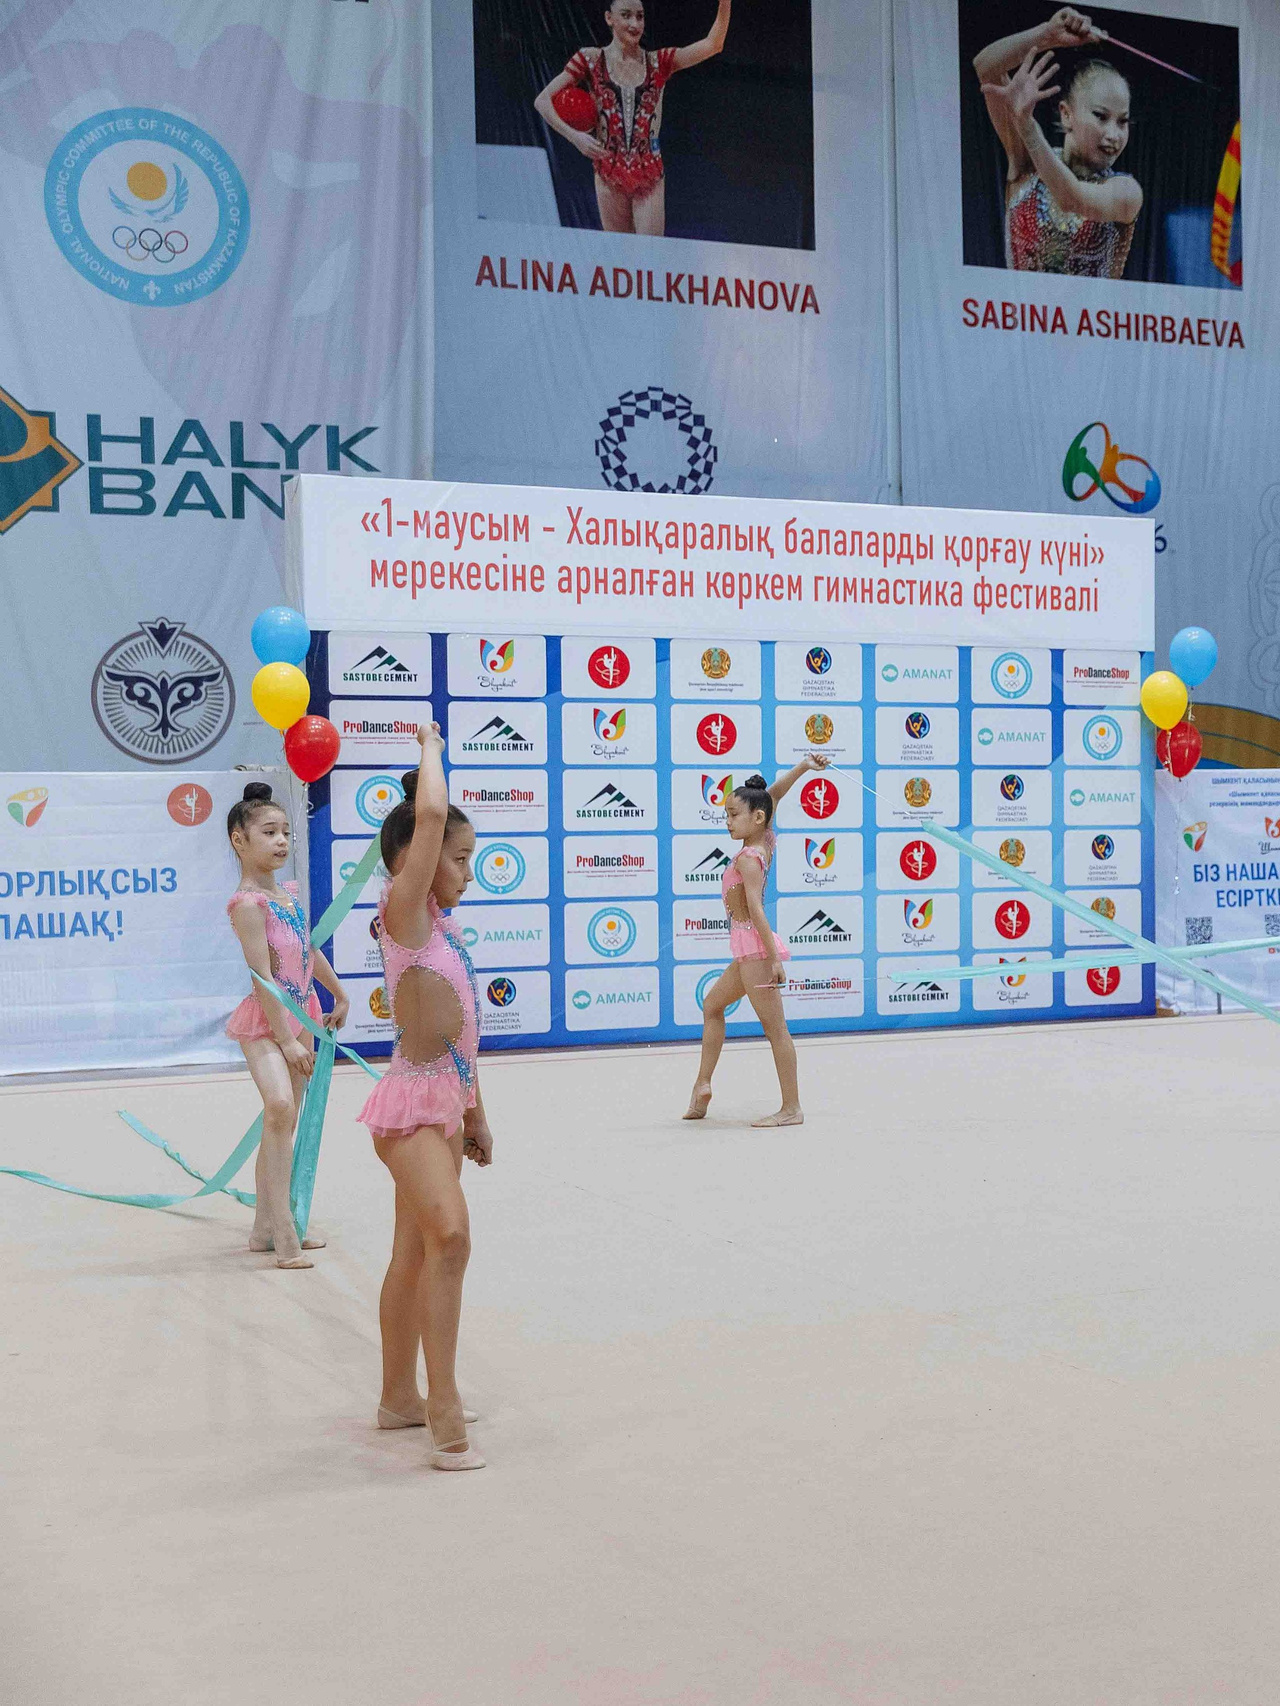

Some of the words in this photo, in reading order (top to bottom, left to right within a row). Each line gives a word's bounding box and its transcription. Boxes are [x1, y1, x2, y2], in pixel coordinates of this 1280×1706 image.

[138, 118, 158, 130] OF
[163, 122, 190, 144] THE
[63, 118, 135, 168] COMMITTEE
[192, 139, 239, 204] REPUBLIC
[56, 170, 74, 234] OLYMPIC
[228, 206, 240, 227] OF
[69, 236, 130, 291] NATIONAL
[173, 228, 239, 294] KAZAKHSTAN
[475, 255, 578, 295] ALINA
[589, 265, 820, 315] ADILKHANOVA
[962, 298, 1068, 335] SABINA
[1077, 308, 1245, 349] ASHIRBAEVA
[87, 414, 381, 473] HALYK
[88, 466, 294, 521] BAN
[361, 498, 530, 551] «1-маусым
[566, 506, 775, 560] Халықаралық
[784, 516, 934, 568] балаларды
[944, 534, 1032, 574] қорғау
[1040, 533, 1105, 575] күні»
[370, 553, 545, 600] мерекесіне
[557, 566, 694, 604] арналған
[706, 569, 803, 610] көркем
[813, 574, 963, 608] гимнастика
[973, 577, 1099, 614] фестивалі
[343, 673, 383, 682] SASTOBE
[384, 673, 418, 682] CEMENT
[902, 668, 953, 680] AMANAT
[1074, 667, 1130, 680] ProDanceShop
[343, 720, 418, 735] ProDanceShop
[997, 732, 1046, 742] AMANAT
[462, 743, 500, 751] SASTOBE
[501, 743, 534, 751] CEMENT
[462, 789, 534, 803] ProDanceShop
[1089, 792, 1135, 803] AMANAT
[576, 809, 612, 818] SASTOBE
[613, 809, 645, 818] CEMENT
[576, 854, 645, 868] ProDanceShop
[685, 873, 720, 882] SASTOBE
[1193, 864, 1220, 883] БІЗ
[483, 929, 543, 942] AMANAT
[789, 935, 822, 944] SASTOBE
[823, 933, 852, 942] CEMENT
[595, 991, 652, 1005] AMANAT
[888, 994, 920, 1003] SASTOBE
[922, 992, 949, 1001] CEMENT
